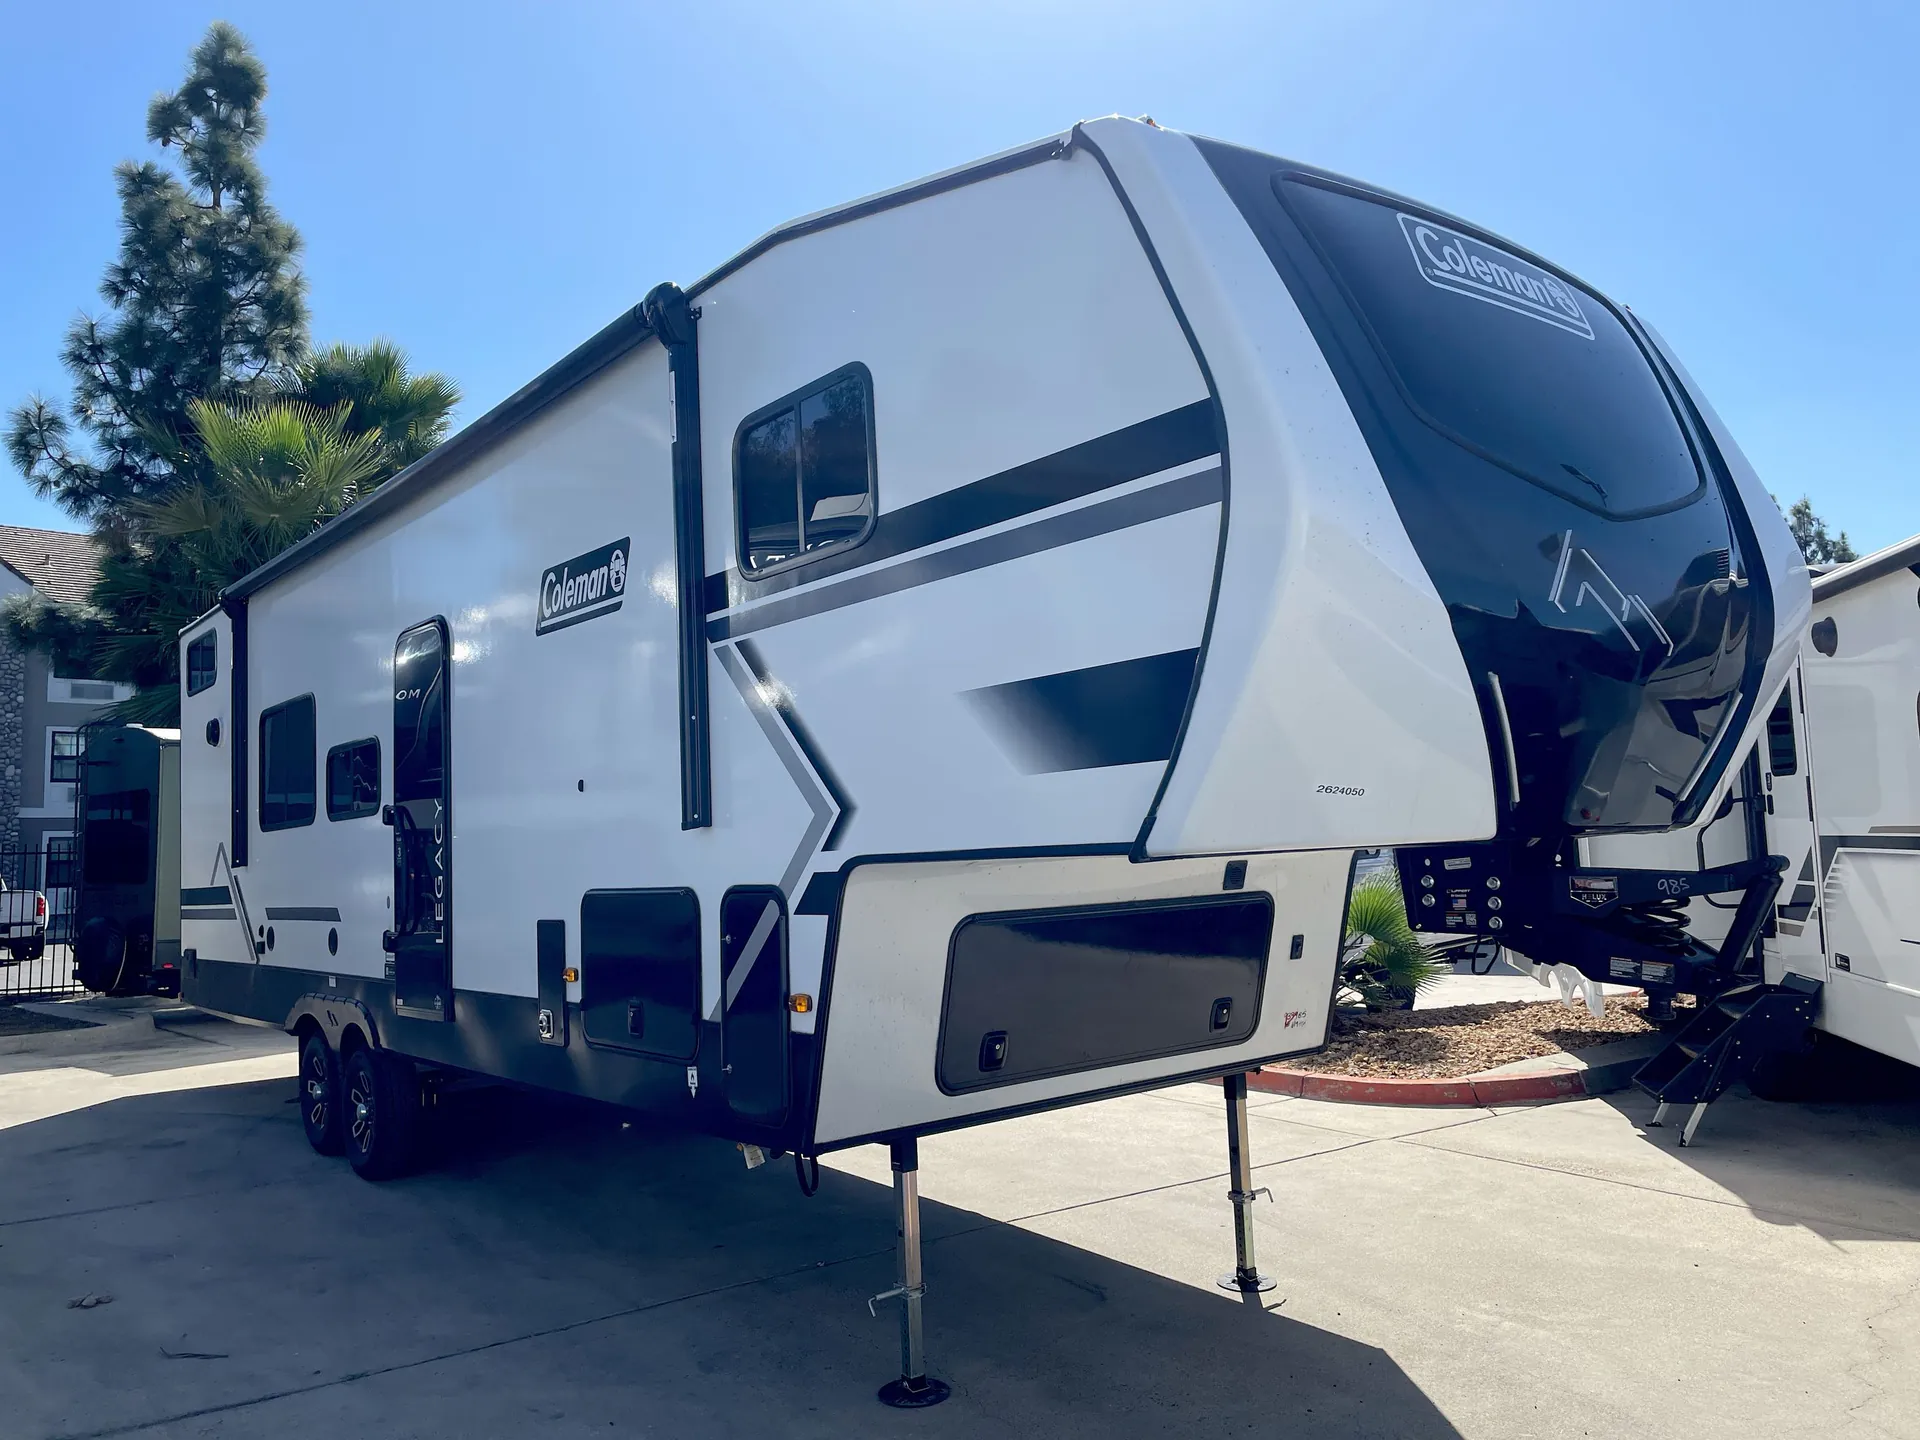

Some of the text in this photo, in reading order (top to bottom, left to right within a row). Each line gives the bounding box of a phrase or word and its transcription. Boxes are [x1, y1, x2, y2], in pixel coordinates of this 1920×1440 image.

[1415, 226, 1555, 306] Coleman
[542, 566, 609, 618] Coleman
[1316, 784, 1365, 797] 2624050
[434, 799, 444, 944] LEGACY
[1657, 878, 1690, 895] 985
